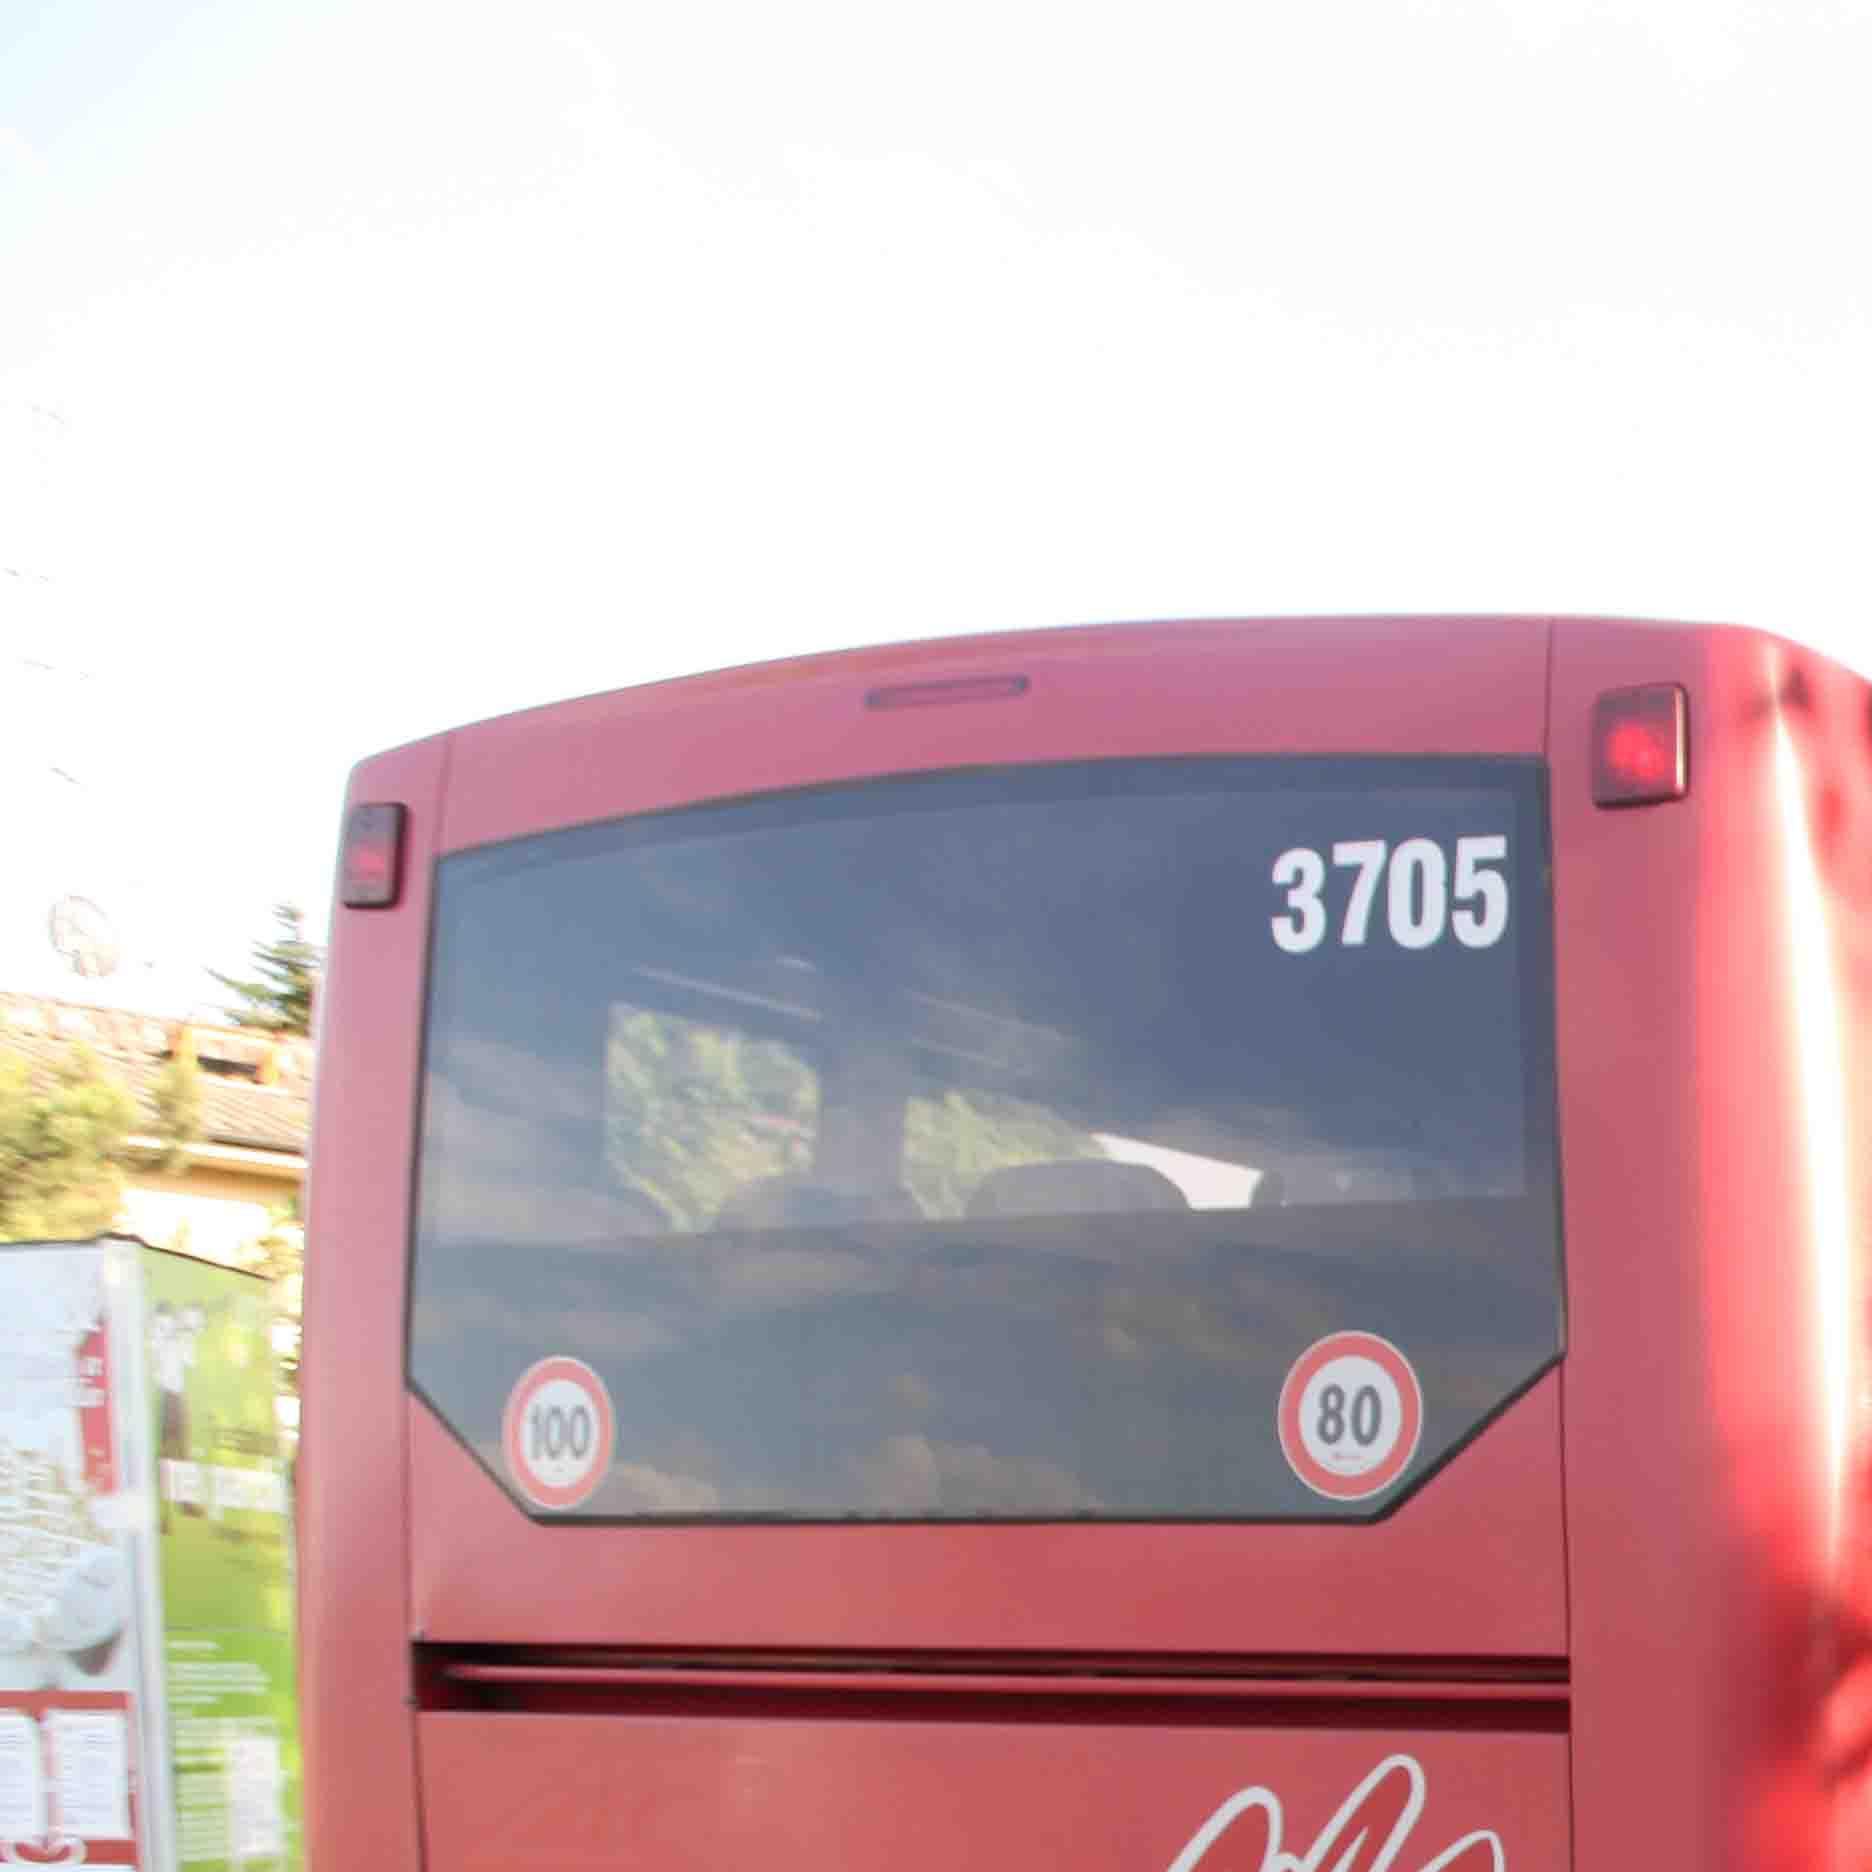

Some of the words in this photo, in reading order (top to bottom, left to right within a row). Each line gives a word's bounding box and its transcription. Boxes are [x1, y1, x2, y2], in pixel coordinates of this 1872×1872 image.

[1271, 834, 1508, 953] 3705
[530, 1405, 591, 1461] 100
[1317, 1384, 1382, 1448] 80
